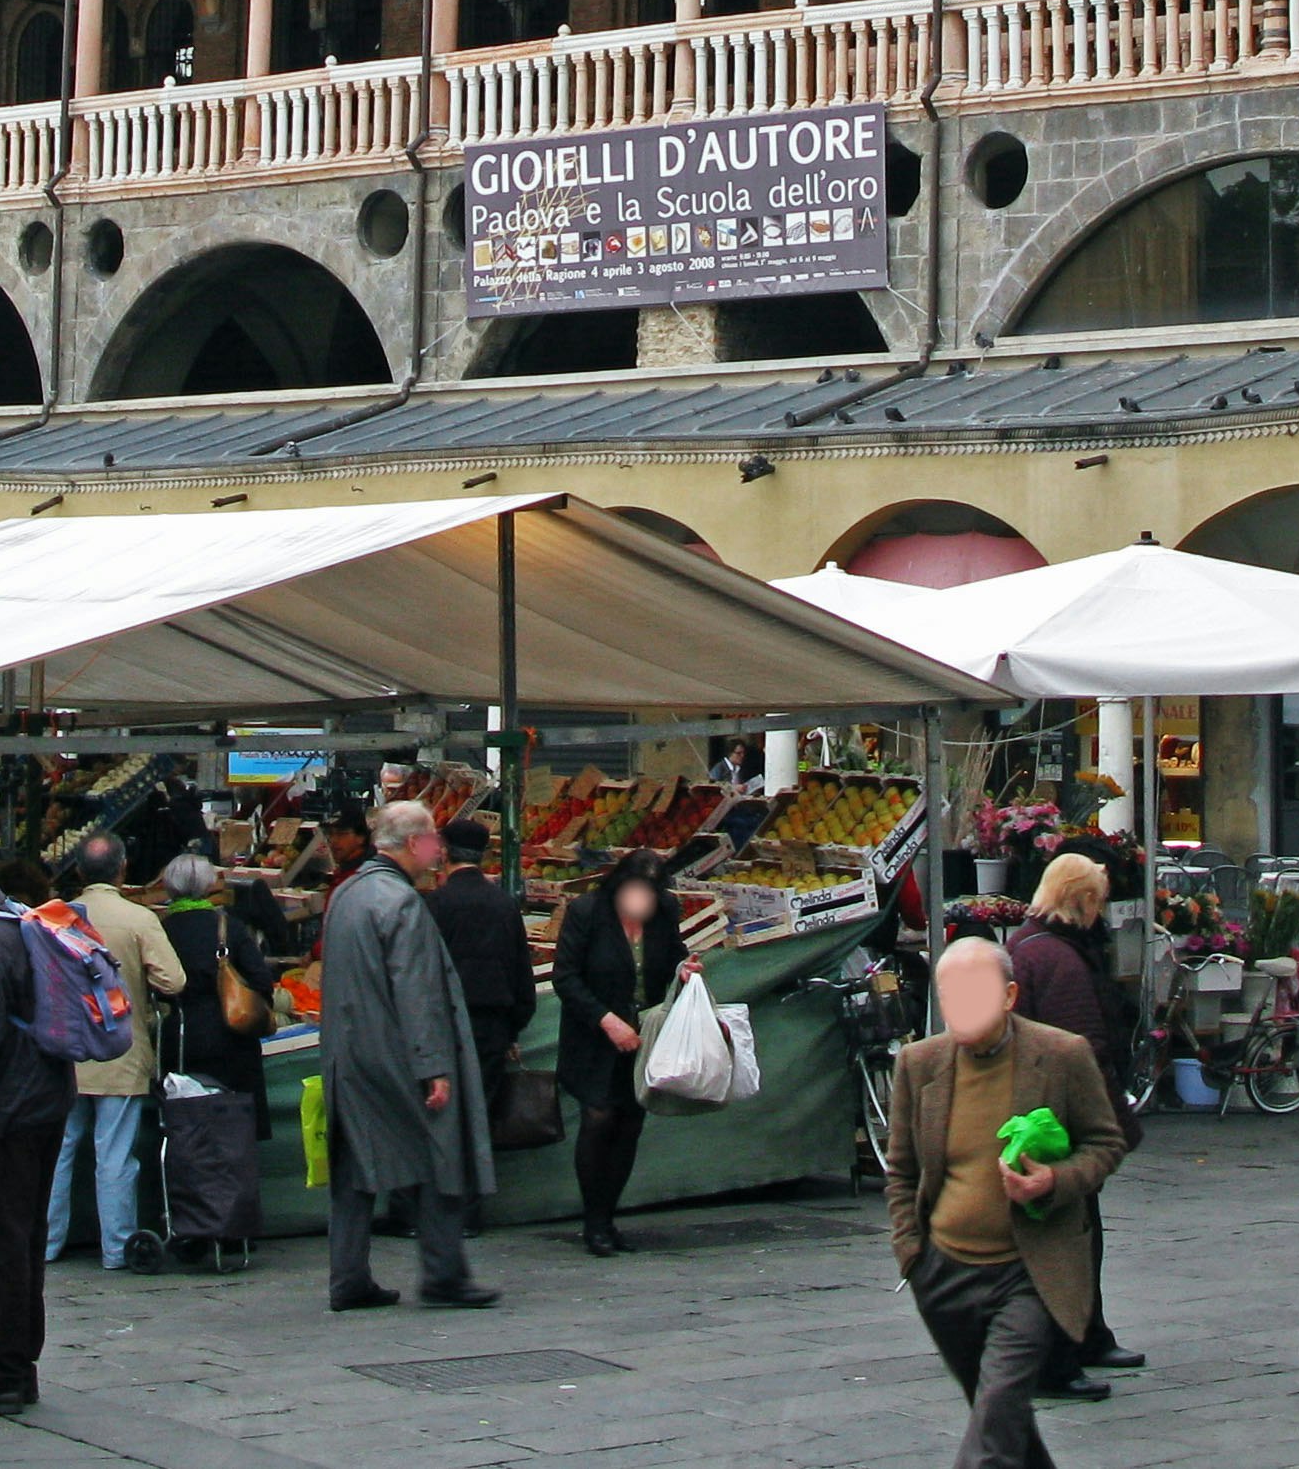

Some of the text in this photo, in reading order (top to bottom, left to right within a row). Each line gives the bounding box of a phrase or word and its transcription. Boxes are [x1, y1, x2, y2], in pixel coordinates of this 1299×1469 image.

[471, 115, 878, 196] GIOIELLI D'AUTORE
[472, 169, 878, 235] Padova e la Scuola dell'oro
[473, 274, 511, 288] Palazzo
[516, 269, 542, 283] della
[546, 267, 587, 283] Ragione
[591, 266, 599, 278] 4
[602, 262, 633, 279] aprile
[637, 261, 645, 275] 3
[649, 260, 685, 277] agosto
[688, 255, 716, 271] 2008
[871, 826, 906, 865] Melinda
[884, 839, 919, 879] Melinda
[790, 889, 833, 910] Melinda
[794, 913, 837, 932] Melinda
